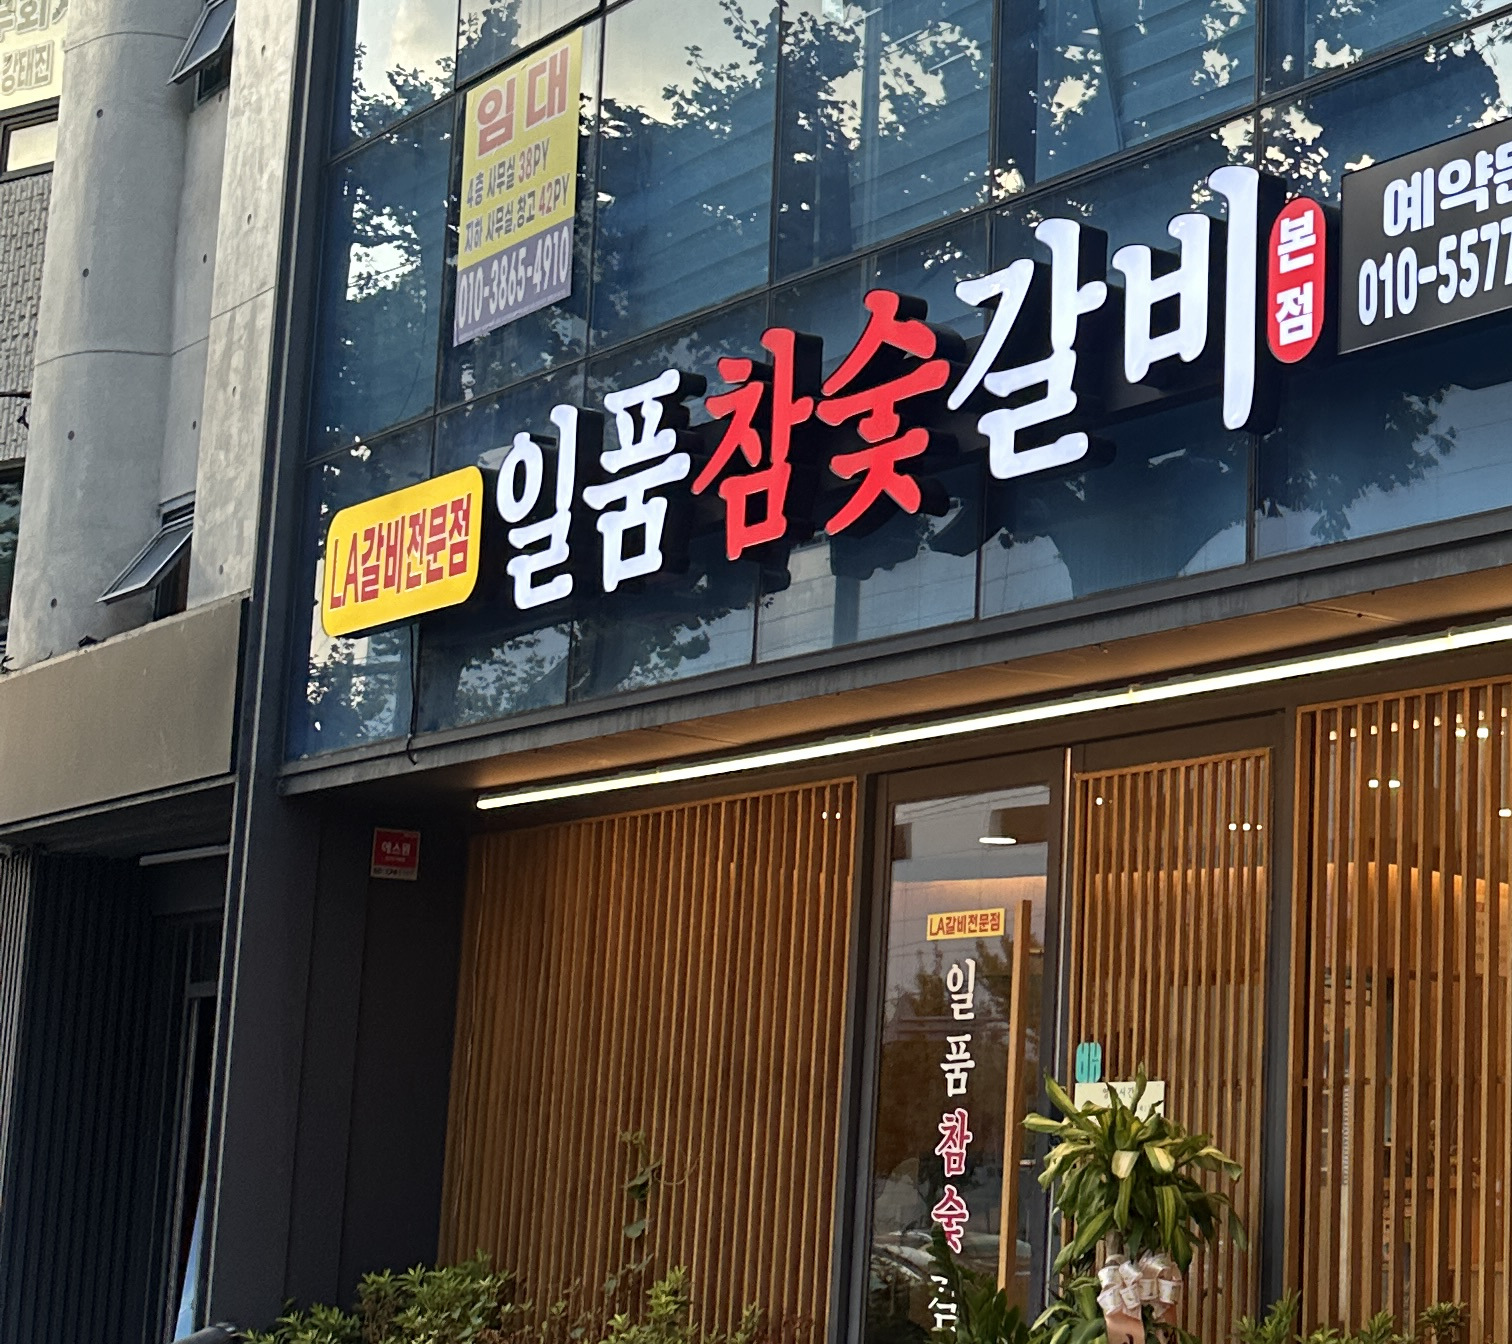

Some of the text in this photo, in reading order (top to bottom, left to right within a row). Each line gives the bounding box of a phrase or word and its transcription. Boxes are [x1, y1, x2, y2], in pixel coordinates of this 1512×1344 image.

[464, 216, 482, 253] 지하
[539, 173, 570, 217] 42PY
[466, 137, 550, 208] 4층 사무실 38PY
[458, 225, 570, 329] 010-3865-4910
[1275, 209, 1317, 346] 본점
[330, 493, 472, 609] LA갈비전문점
[929, 911, 1001, 936] LA갈비전문점
